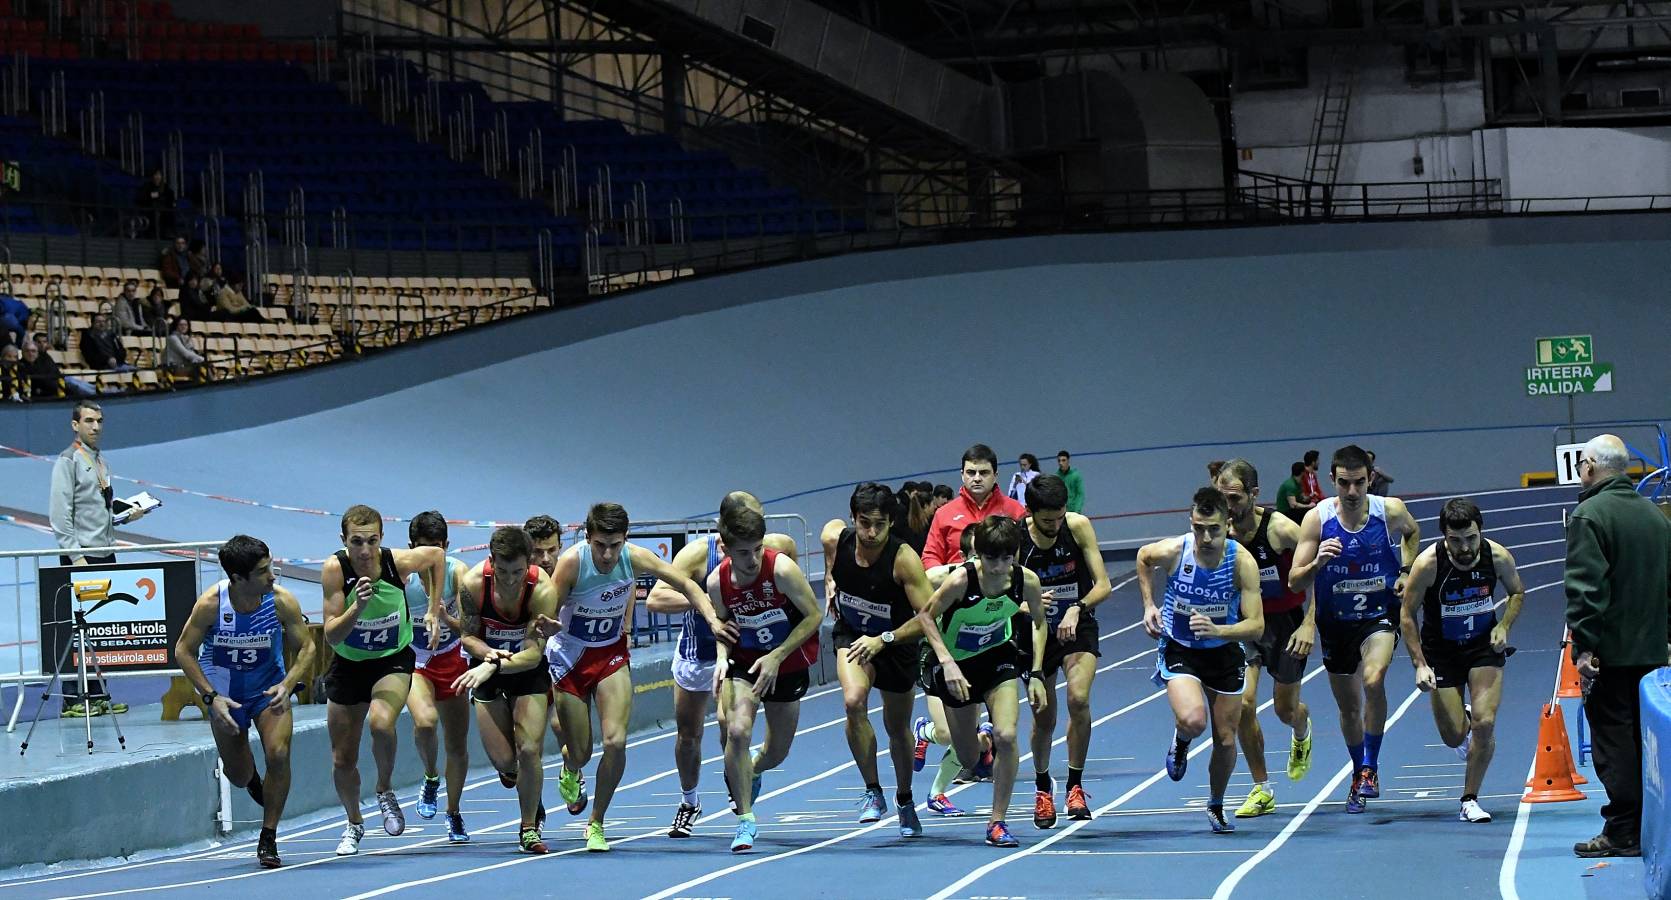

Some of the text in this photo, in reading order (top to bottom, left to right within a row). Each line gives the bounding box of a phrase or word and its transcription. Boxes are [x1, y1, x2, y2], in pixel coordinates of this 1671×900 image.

[1527, 366, 1594, 380] IRTEERA
[1528, 381, 1584, 395] SALIDA
[1173, 581, 1219, 600] TOLOSA
[1353, 594, 1367, 611] 2
[857, 612, 872, 625] 7
[1463, 615, 1474, 631] 1
[131, 621, 167, 635] kirola
[584, 619, 613, 634] 10
[100, 638, 167, 647] SEBASTIÁN
[360, 629, 389, 644] 14
[756, 627, 774, 644] 8
[978, 632, 993, 646] 6
[226, 649, 258, 663] 13
